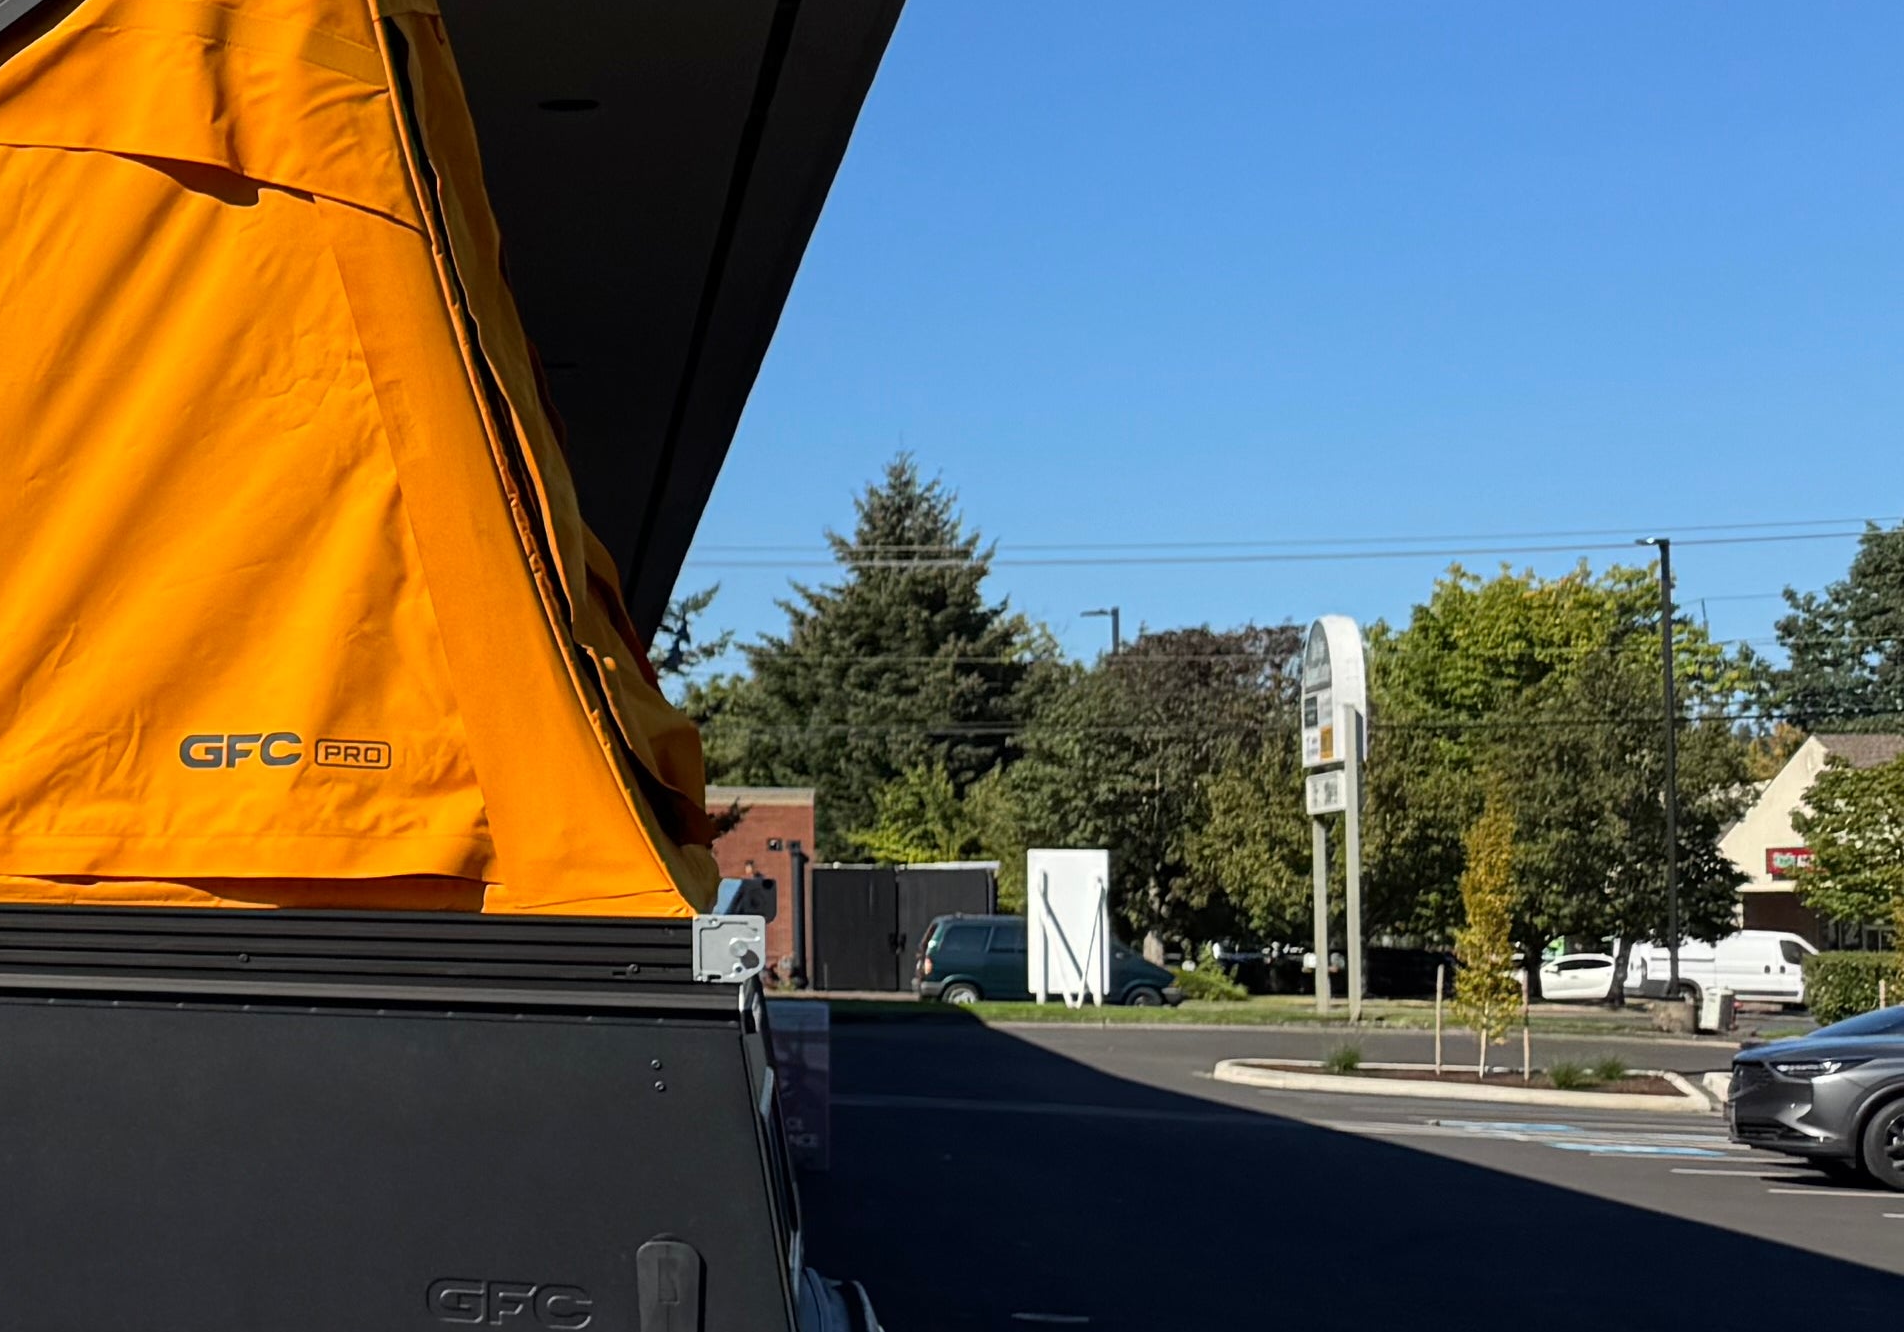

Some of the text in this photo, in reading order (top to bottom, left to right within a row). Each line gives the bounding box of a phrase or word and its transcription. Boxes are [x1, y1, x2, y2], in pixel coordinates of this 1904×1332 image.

[178, 731, 382, 769] GFC PRO
[425, 1276, 593, 1330] GFC
